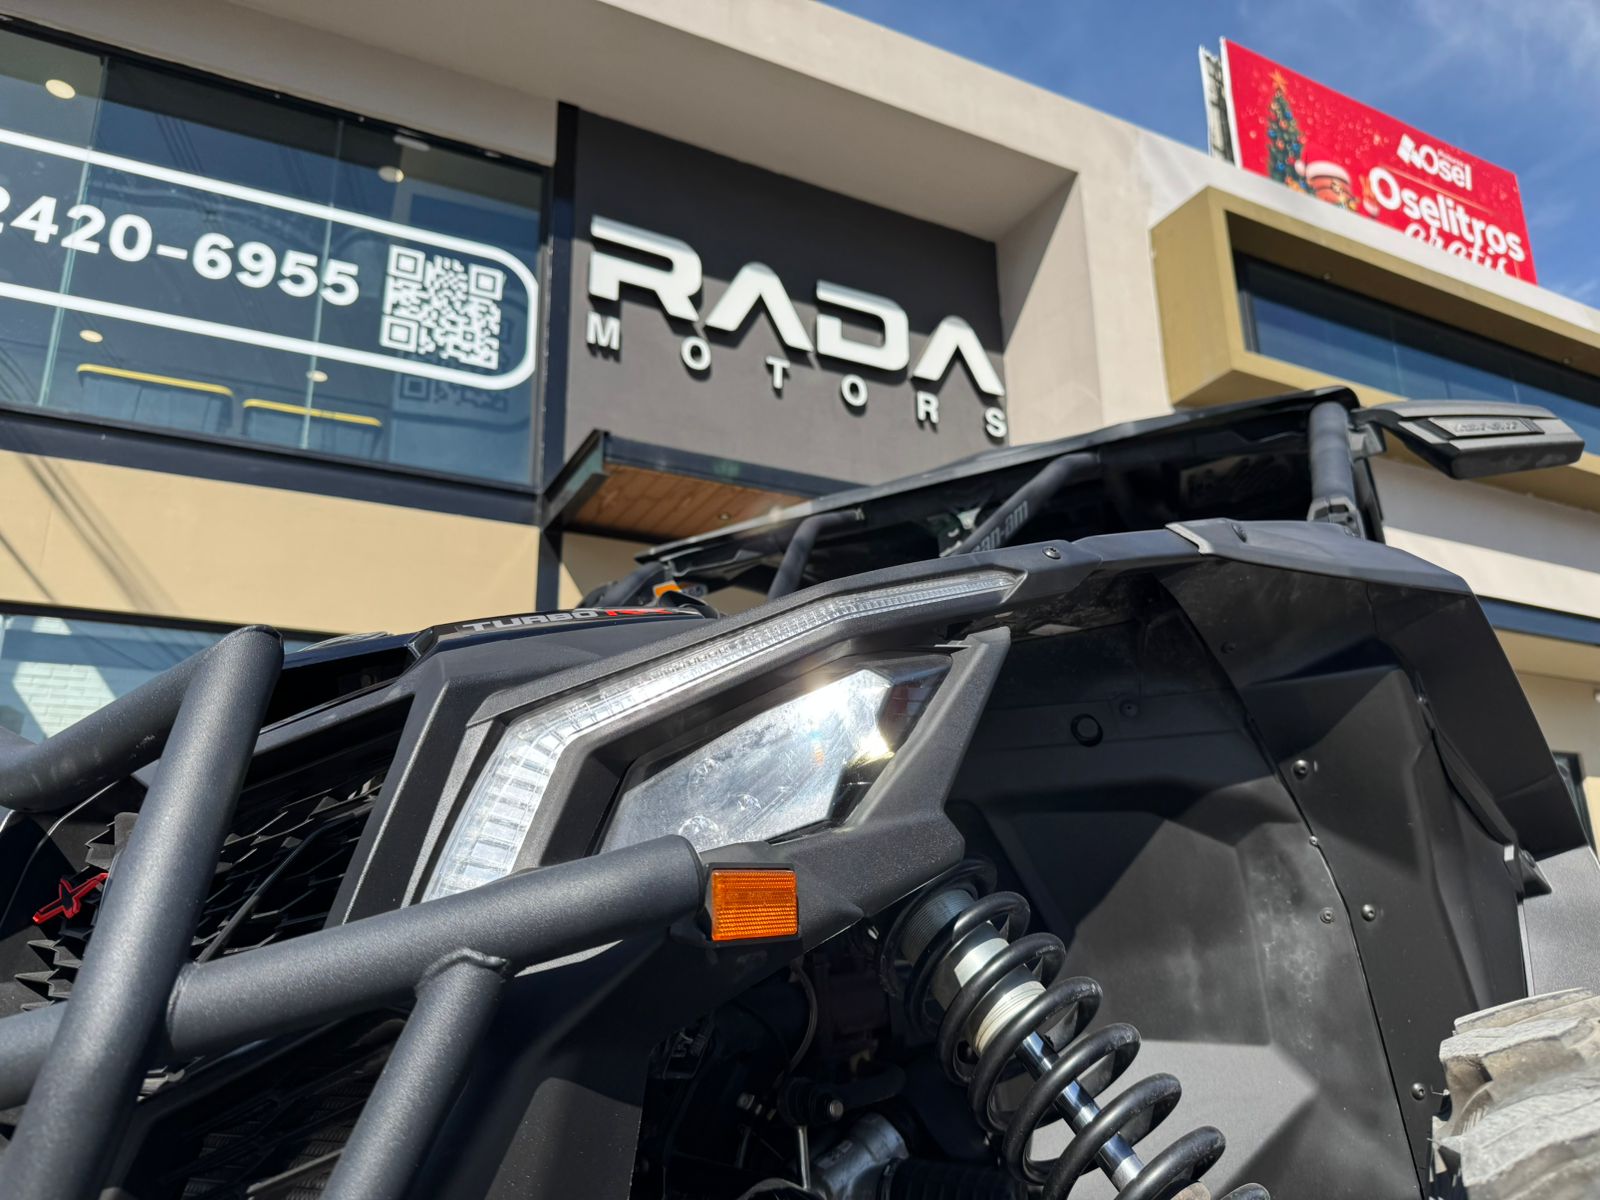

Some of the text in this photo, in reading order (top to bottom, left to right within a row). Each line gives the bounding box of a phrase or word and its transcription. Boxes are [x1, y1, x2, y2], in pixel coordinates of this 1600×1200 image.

[1370, 168, 1525, 262] Oselitros
[1419, 145, 1472, 191] Osel
[0, 185, 360, 306] 420-6955
[590, 215, 1004, 396] RADA
[587, 311, 1007, 438] MOTORS
[462, 609, 599, 632] TURBO
